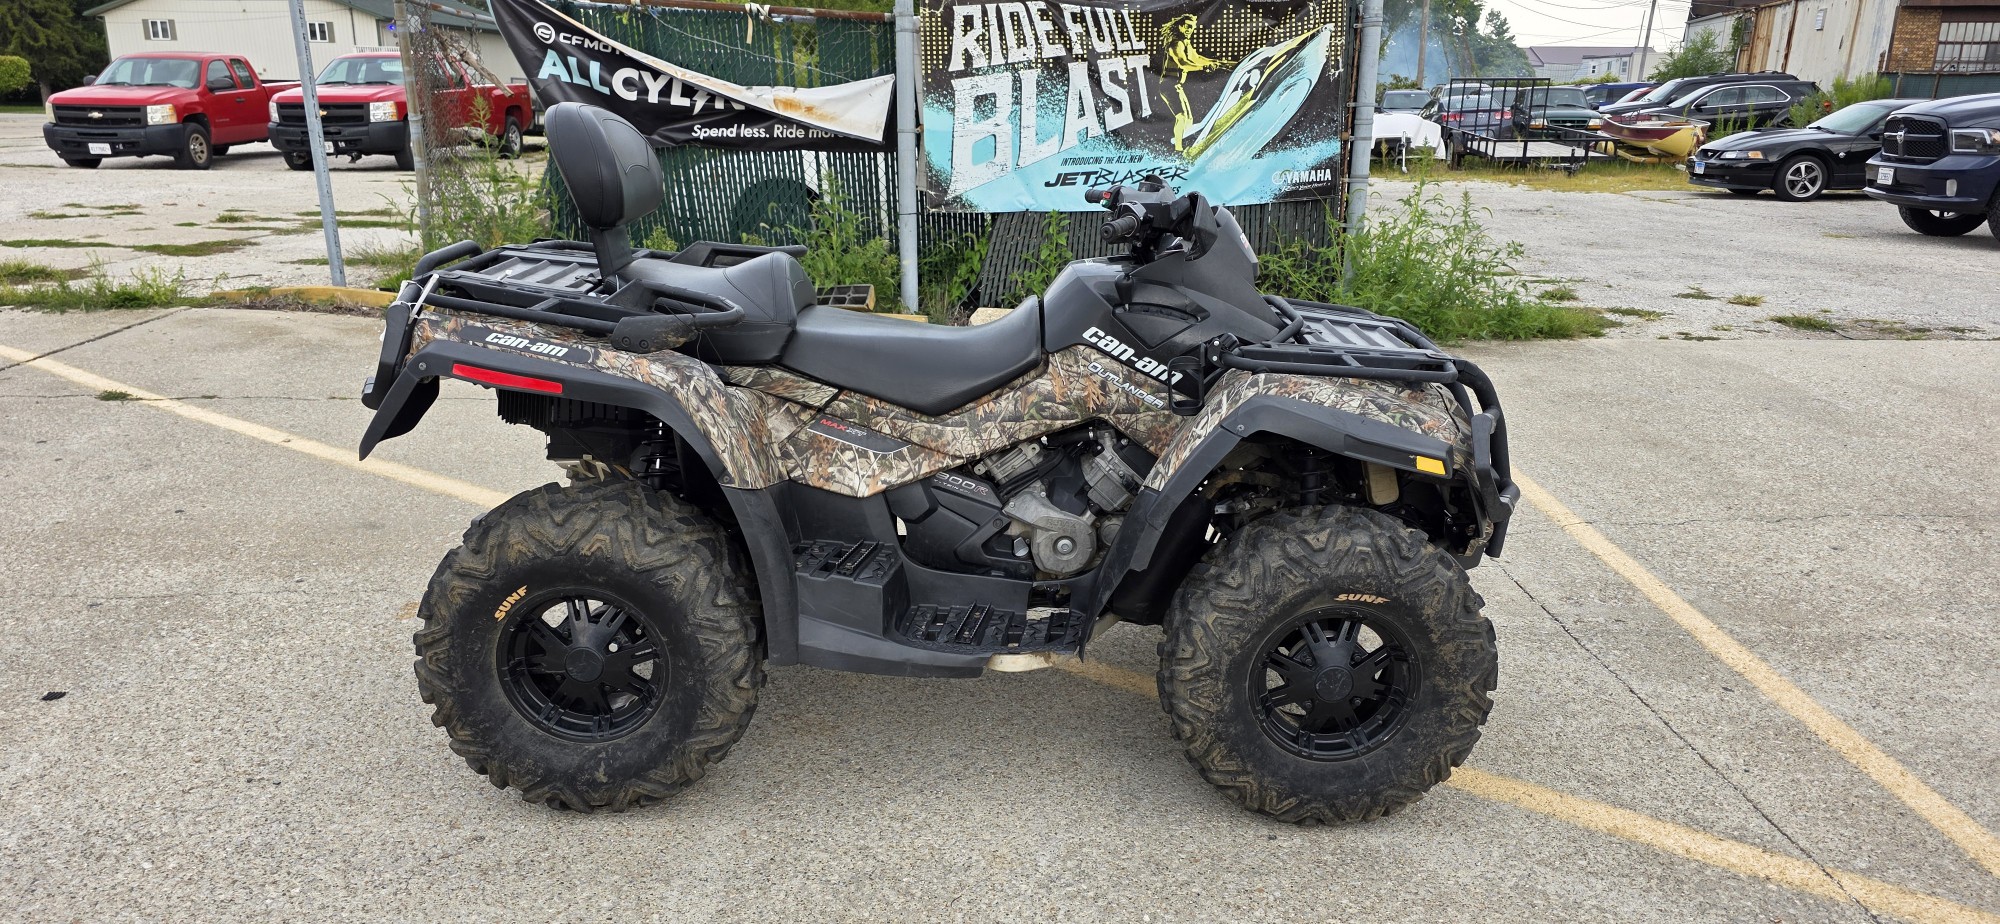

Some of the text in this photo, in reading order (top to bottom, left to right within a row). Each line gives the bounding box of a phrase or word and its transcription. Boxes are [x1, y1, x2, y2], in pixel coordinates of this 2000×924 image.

[559, 33, 628, 56] CFMO
[948, 1, 1146, 72] RIDE FULL
[537, 48, 611, 95] ALL
[691, 123, 737, 140] Spend
[740, 123, 770, 138] less.
[773, 124, 805, 138] Ride
[945, 54, 1153, 200] BLAST
[1060, 154, 1145, 167] INTRODUCING THE ALL-NEW
[1286, 168, 1332, 184] YAMAHA
[485, 332, 568, 357] can-am
[1082, 326, 1184, 385] can-am
[1087, 361, 1165, 409] OUTLANDER
[820, 418, 848, 431] MAX
[494, 585, 528, 622] SUNF
[1334, 593, 1391, 604] SUNF
